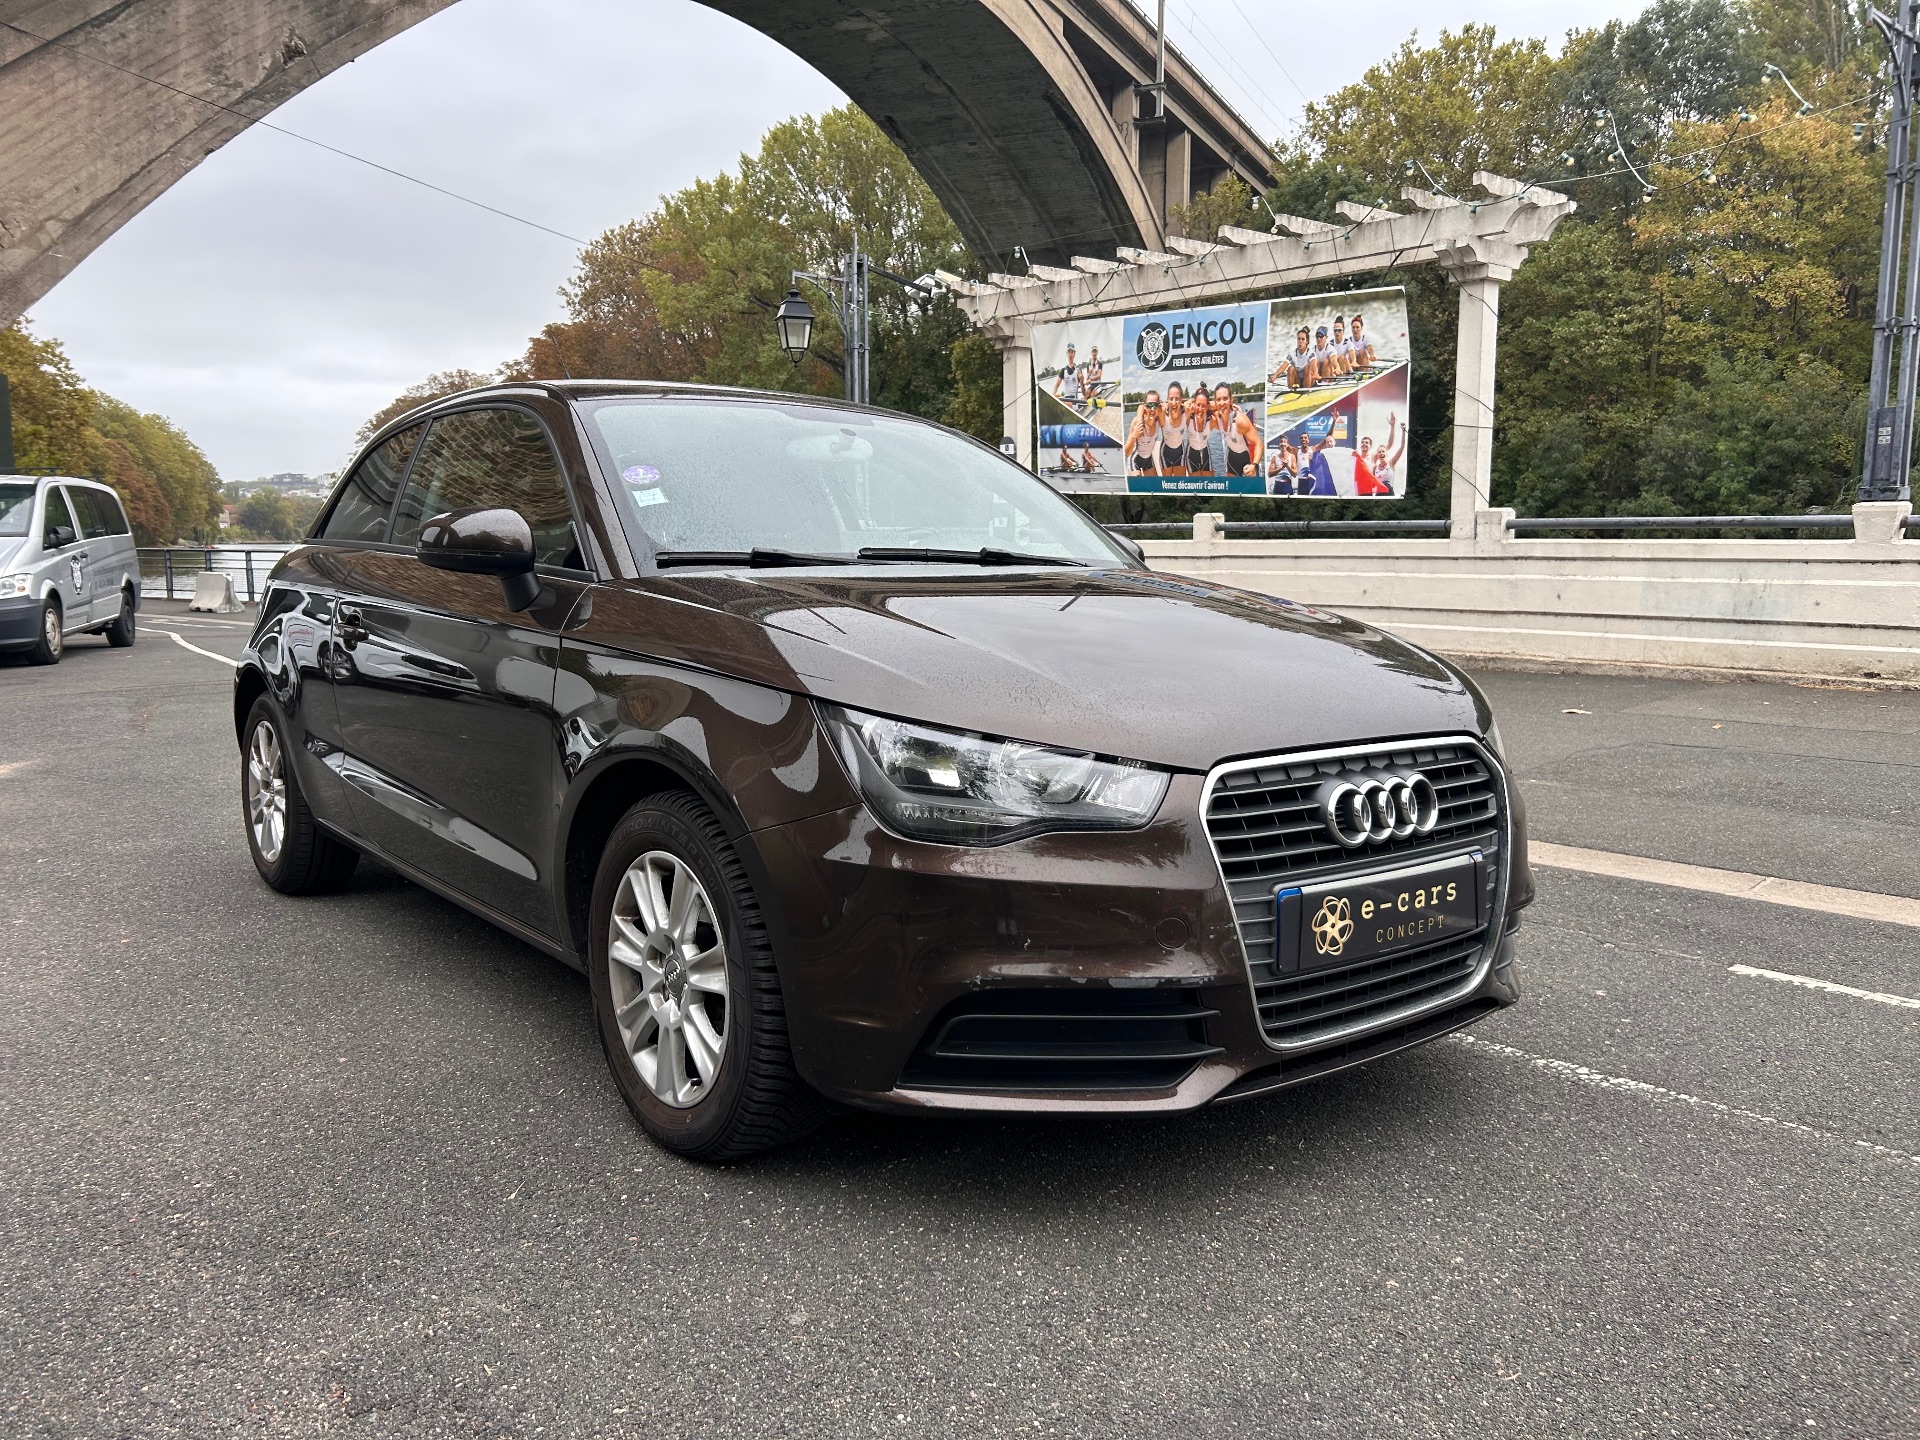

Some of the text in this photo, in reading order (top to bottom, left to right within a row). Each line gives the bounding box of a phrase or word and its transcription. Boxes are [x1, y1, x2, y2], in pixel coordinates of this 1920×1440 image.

[1171, 317, 1255, 349] ENCOU
[1172, 358, 1184, 367] FIER
[1184, 357, 1191, 366] DE
[1191, 357, 1201, 366] SES
[1080, 427, 1102, 438] PARIS
[1161, 480, 1177, 489] Venez
[1177, 480, 1203, 490] découvrir
[612, 817, 698, 856] EUROWINTER
[1361, 881, 1458, 920] e-cars
[1375, 914, 1445, 943] CONCEPT
